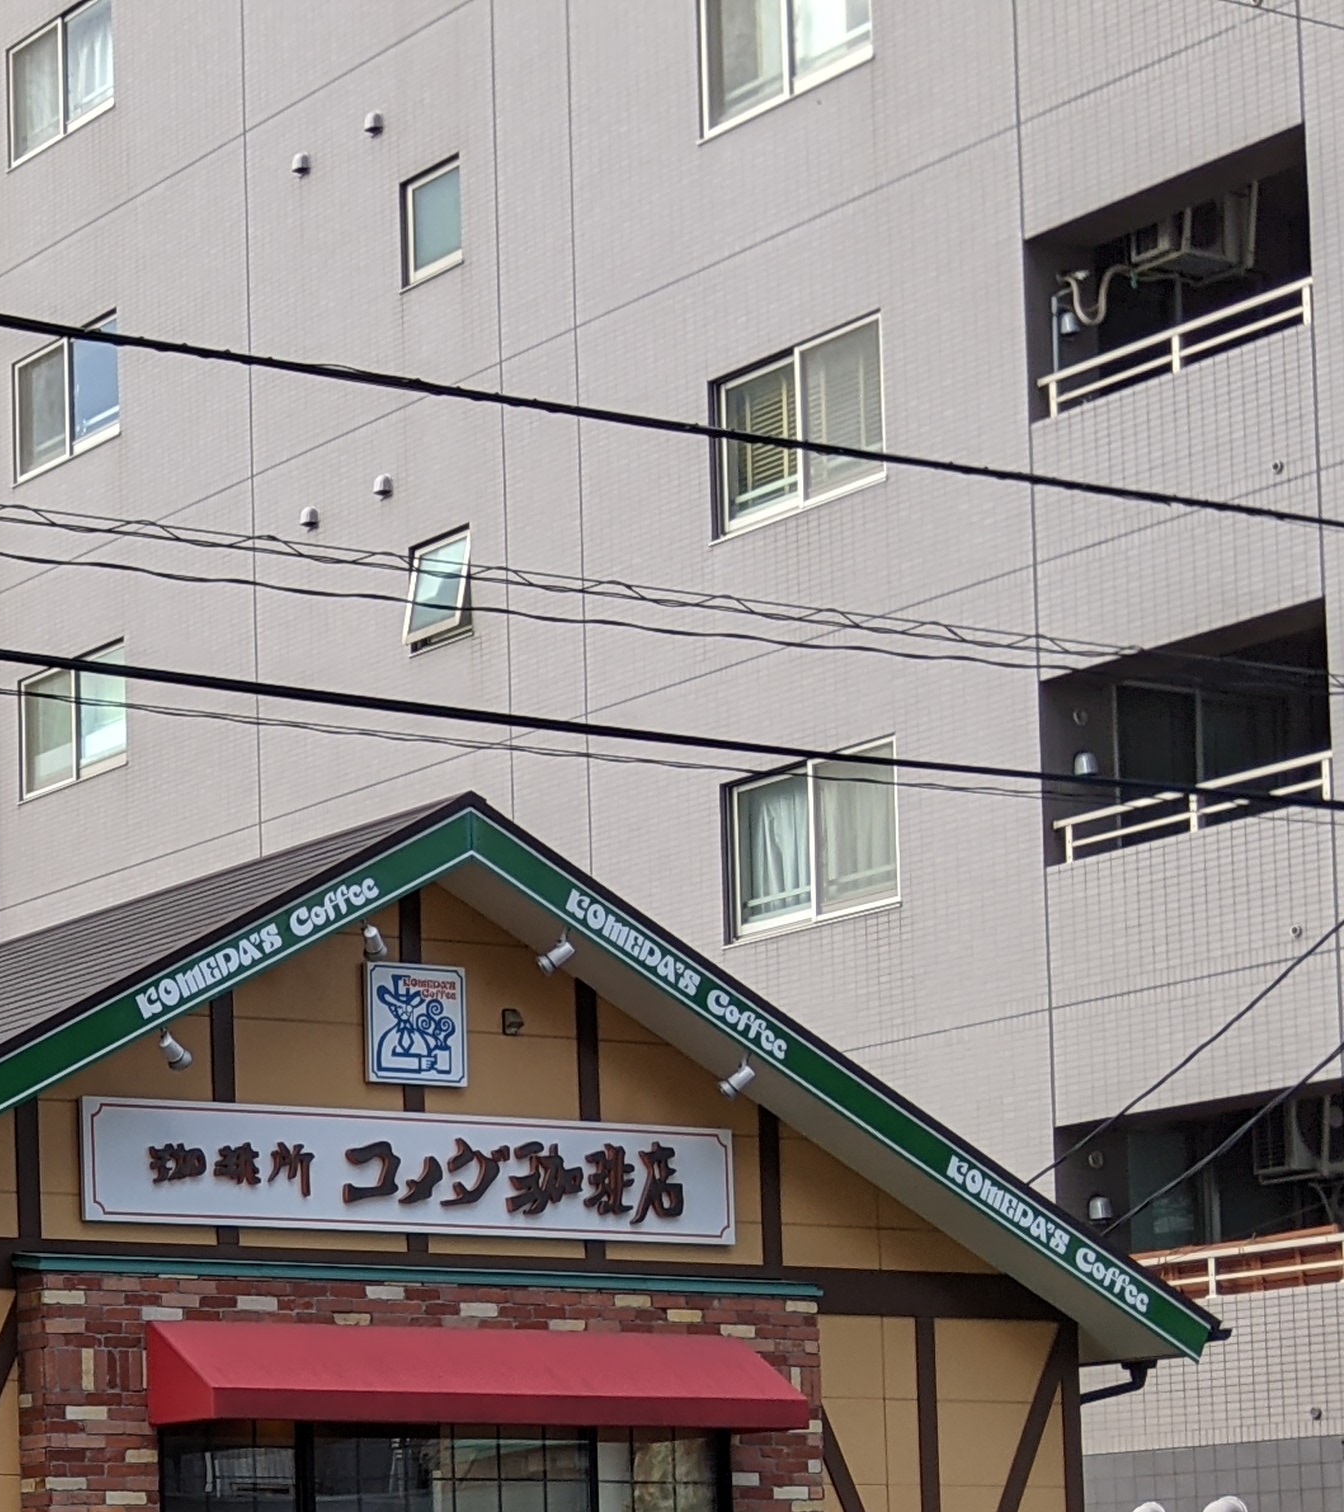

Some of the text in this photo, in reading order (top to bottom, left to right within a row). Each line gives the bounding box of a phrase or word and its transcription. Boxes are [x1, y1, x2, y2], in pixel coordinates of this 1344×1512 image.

[135, 876, 380, 1020] KOMEDA'S Coffee
[565, 888, 788, 1062] KOMEDA'S Coffee
[342, 1137, 685, 1225] コメダ珈琲店
[946, 1155, 1150, 1316] KOMEDA'S Coffee
